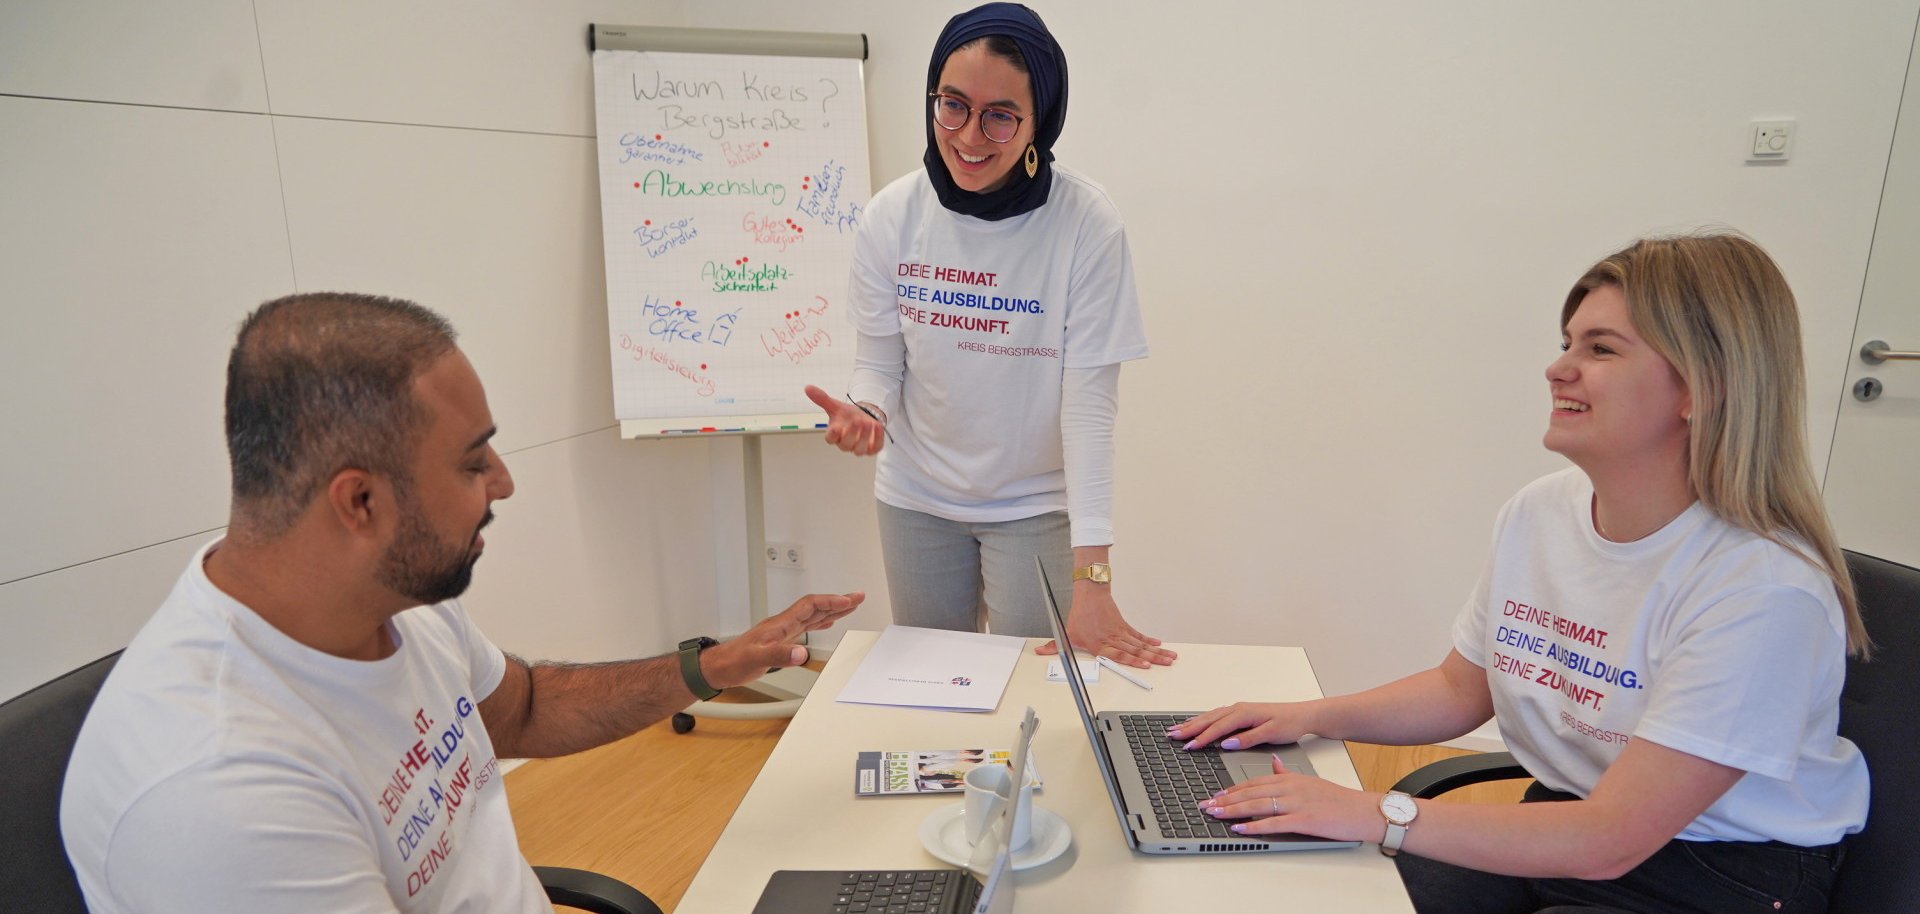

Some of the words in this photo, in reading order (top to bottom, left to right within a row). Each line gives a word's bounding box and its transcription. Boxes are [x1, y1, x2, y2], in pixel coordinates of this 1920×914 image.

[633, 71, 723, 100] Warum
[743, 71, 808, 101] Kreis
[656, 104, 805, 139] Bergstraße
[643, 169, 786, 206] Abwechslung
[742, 211, 787, 233] Gutes
[934, 267, 998, 287] HEIMAT.
[642, 295, 699, 323] Home
[931, 290, 1044, 314] AUSBILDUNG.
[649, 318, 703, 343] Office
[929, 312, 1010, 335] ZUKUNFT.
[957, 341, 986, 353] KREIS
[988, 345, 1059, 358] BERGSTRASSE
[1503, 600, 1551, 629] DEINE
[1552, 615, 1608, 649] HEIMAT.
[1496, 626, 1546, 655] DEINE
[1493, 652, 1536, 680] DEINE
[1577, 721, 1629, 745] BERGSTR
[396, 799, 435, 862] DEINE
[407, 831, 453, 897] DEINE
